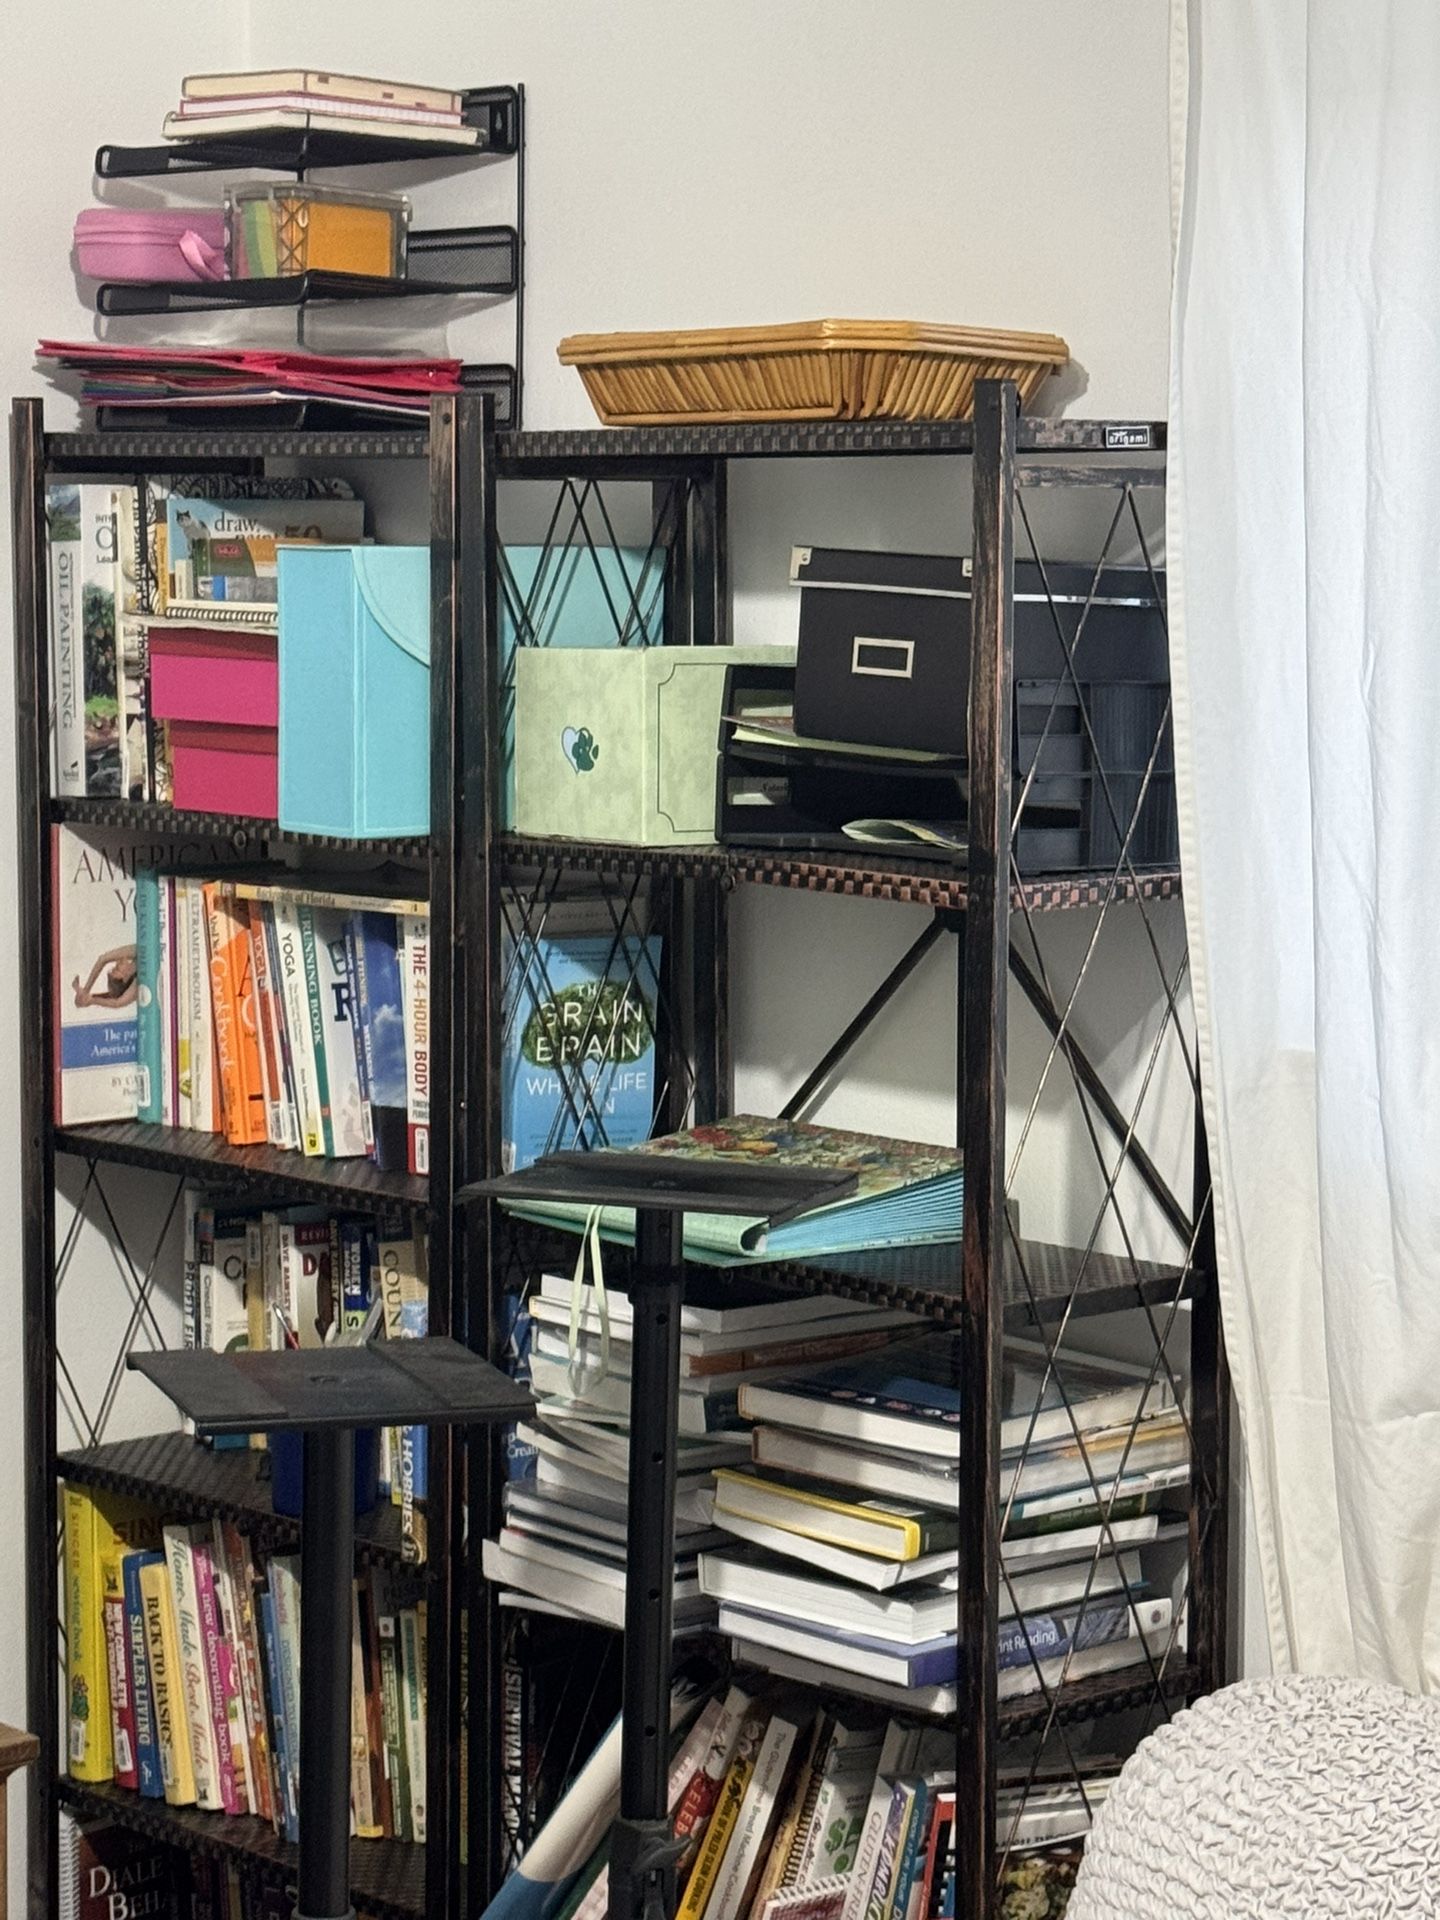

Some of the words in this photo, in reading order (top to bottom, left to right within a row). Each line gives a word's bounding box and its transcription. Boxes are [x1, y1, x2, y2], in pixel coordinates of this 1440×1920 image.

[58, 551, 69, 597] OIL
[59, 604, 73, 730] PAINTING
[189, 892, 202, 1020] ULTRAMETABOLISM
[281, 932, 296, 978] YOGA
[301, 920, 318, 993] RUNNING
[412, 944, 427, 977] THE
[210, 956, 231, 1072] Cookbook
[309, 998, 323, 1045] BOOK
[412, 980, 427, 1045] 4-HOUR
[540, 999, 643, 1027] GRAIN
[413, 1050, 428, 1097] BODY
[281, 1233, 290, 1262] DAVE
[182, 1261, 195, 1319] PROFIT
[281, 1265, 291, 1312] RAMSEY
[401, 1437, 414, 1535] HOBBIES
[146, 1596, 163, 1645] BACK
[202, 1592, 214, 1629] new
[130, 1613, 146, 1687] SIMPLER
[152, 1649, 166, 1675] TO
[206, 1631, 226, 1718] decorating
[135, 1688, 151, 1746] LIVING
[503, 1669, 522, 1771] SURVIVAL
[215, 1722, 230, 1763] book
[744, 1804, 761, 1834] Bread
[731, 1833, 752, 1873] Machine
